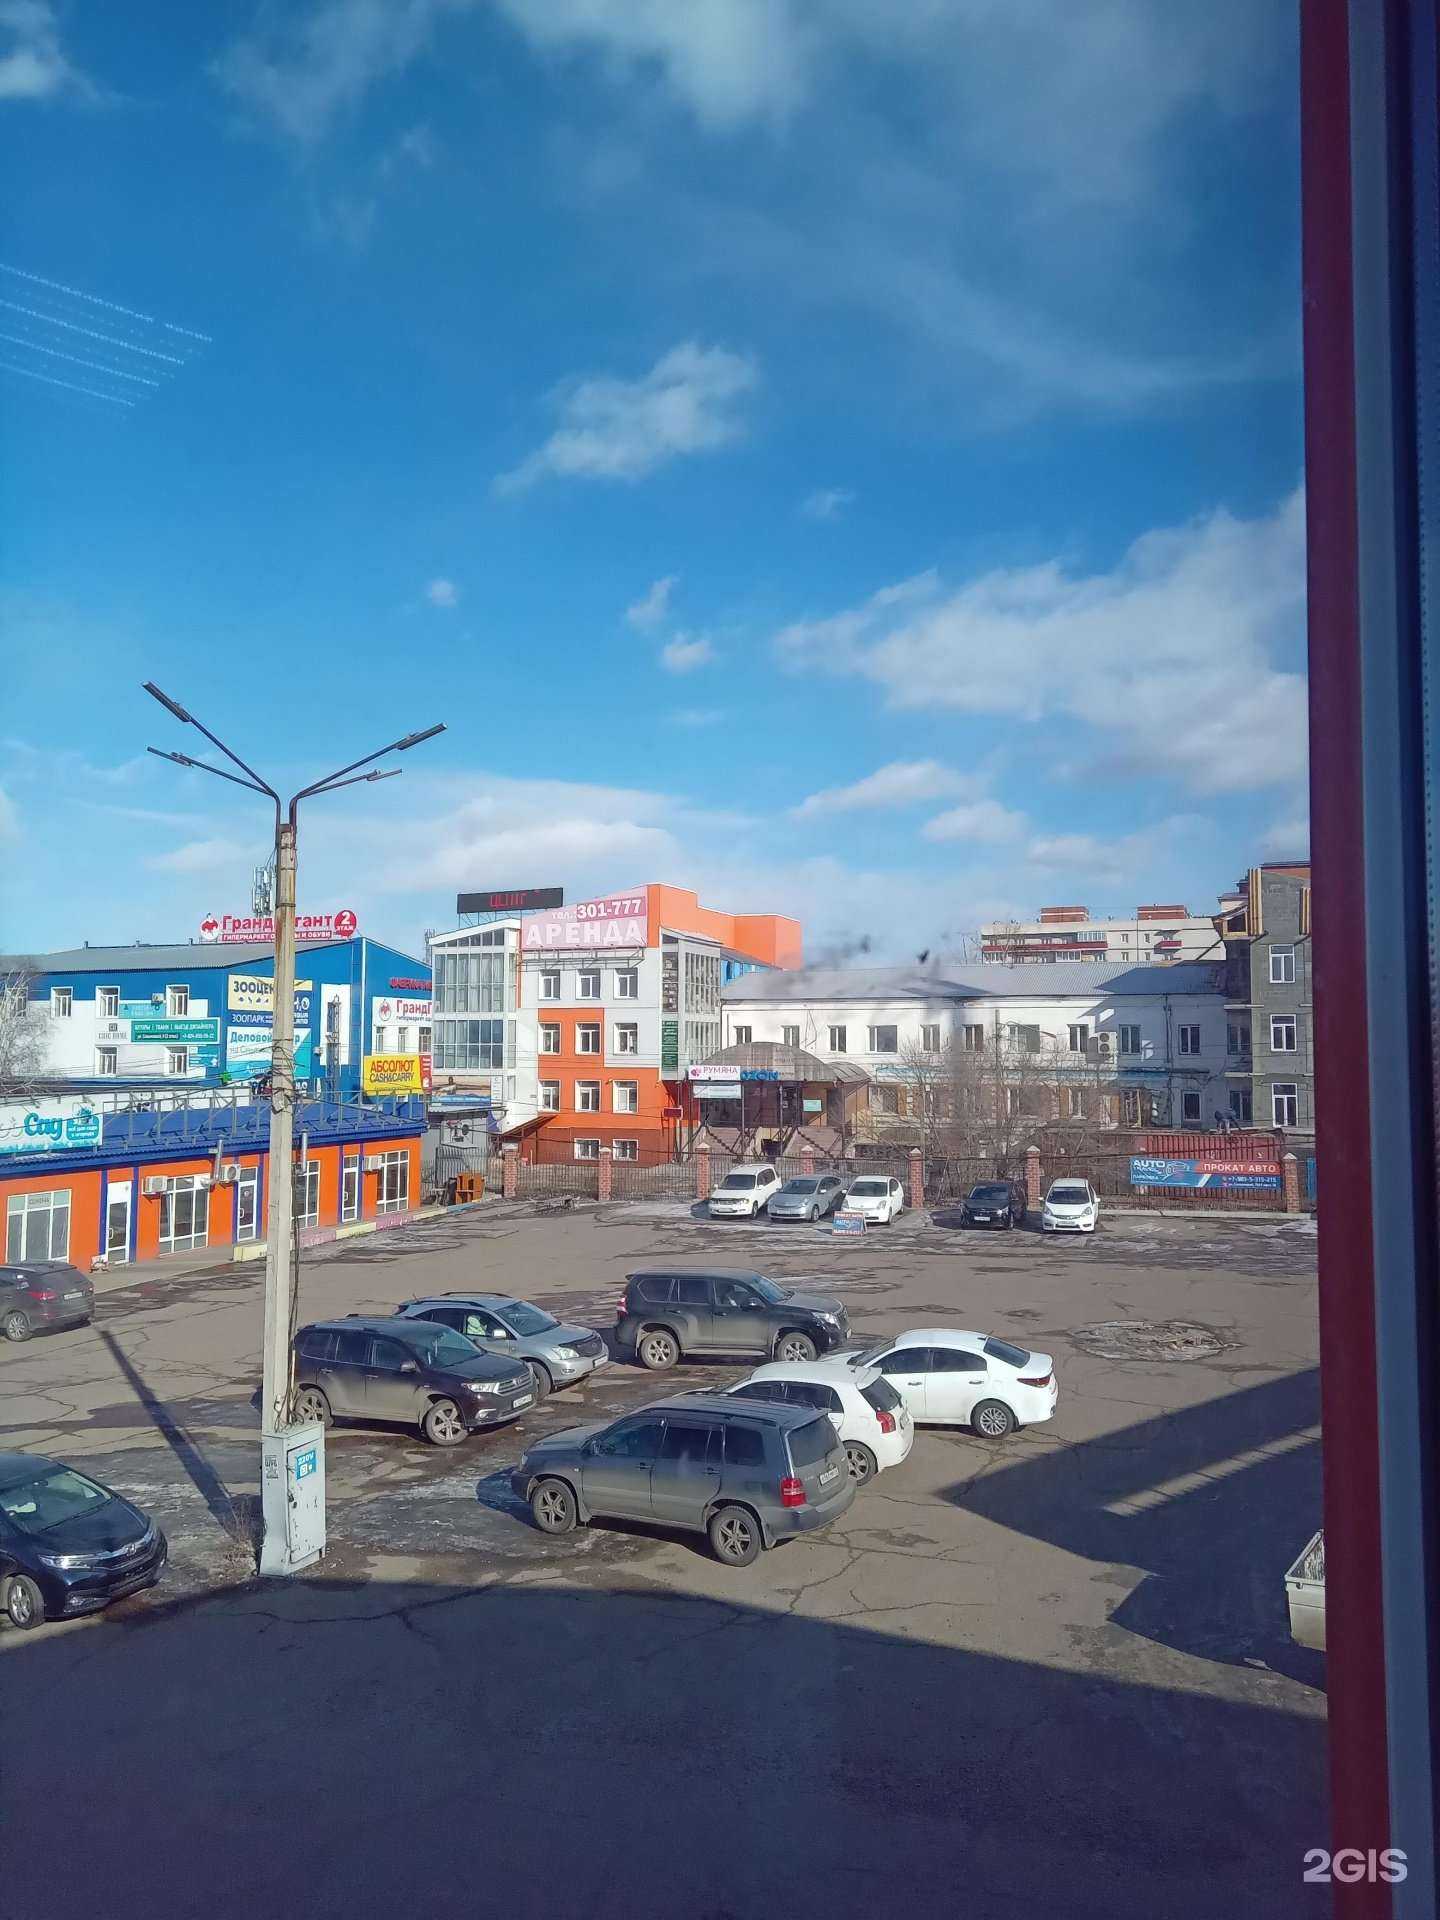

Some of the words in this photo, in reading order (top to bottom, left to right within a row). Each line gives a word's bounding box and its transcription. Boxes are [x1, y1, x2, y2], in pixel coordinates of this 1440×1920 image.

[577, 899, 642, 919] 301-777
[222, 915, 333, 932] Грандгант
[341, 911, 350, 925] 2
[223, 932, 270, 941] ГИПЕРМАРКЕТ
[307, 931, 331, 939] ОБУВИ
[525, 920, 642, 947] АРЕНДА
[396, 1000, 432, 1016] ГрандГ
[231, 1013, 265, 1023] ЗООПАРК
[370, 1060, 415, 1073] АБСОЛЮТ
[703, 1066, 738, 1074] РУМЯНА
[369, 1072, 415, 1083] CASH&CARRY
[740, 1069, 779, 1081] OZON
[1133, 1160, 1166, 1169] AUTO
[1203, 1163, 1245, 1172] ПРОКАТ
[1248, 1164, 1276, 1173] АВТО
[297, 1451, 314, 1466] 220V
